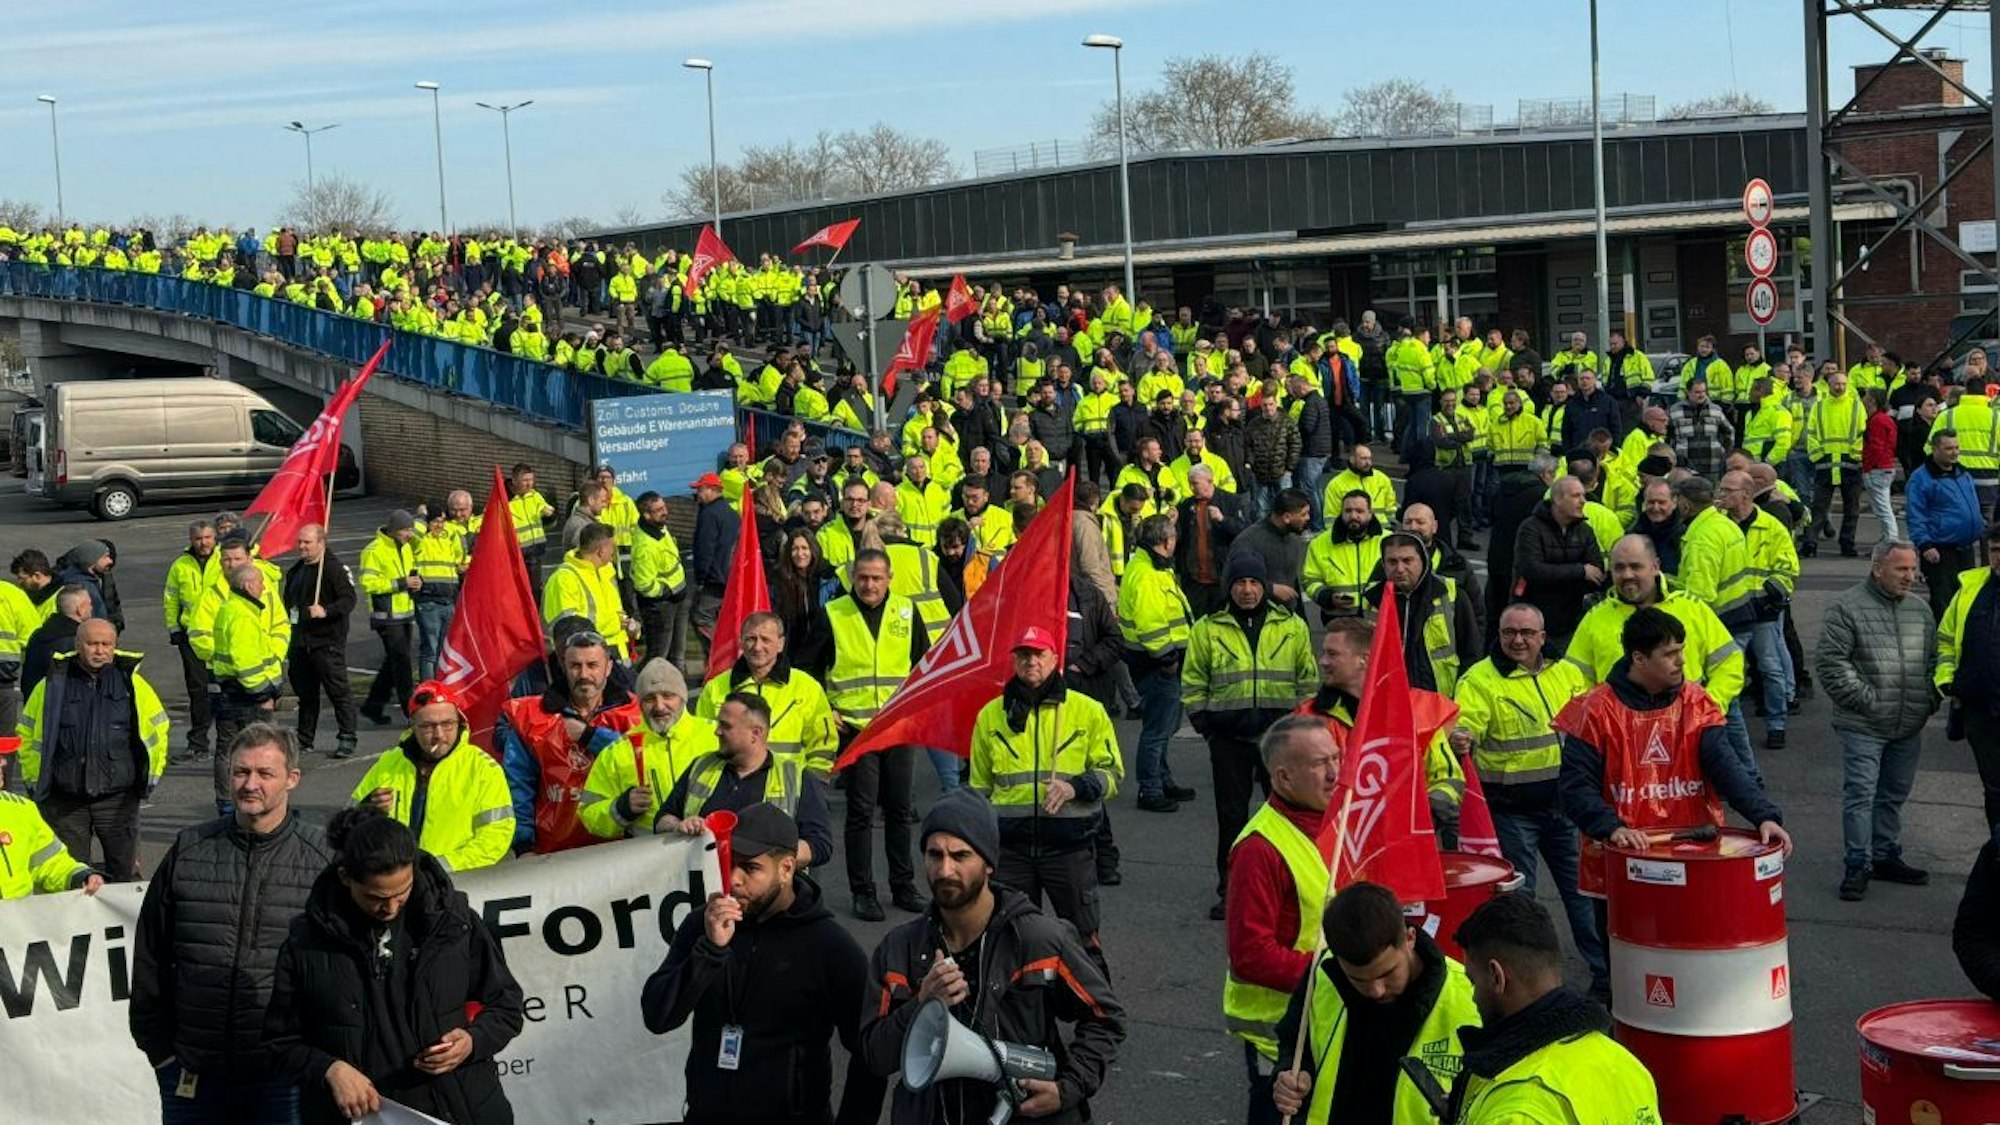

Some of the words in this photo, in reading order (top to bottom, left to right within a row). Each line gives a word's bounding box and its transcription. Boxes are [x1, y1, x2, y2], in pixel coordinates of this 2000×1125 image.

[598, 410, 619, 421] Zoll
[625, 405, 673, 419] Customs
[598, 422, 647, 437] Gebäude
[649, 421, 657, 433] E
[658, 415, 735, 432] Warenannahme
[599, 437, 669, 454] Versandlager
[614, 469, 648, 484] sfahrt
[0, 926, 131, 1018] Wi
[483, 870, 706, 956] Ford
[564, 984, 594, 1019] R
[496, 1057, 535, 1077] per
